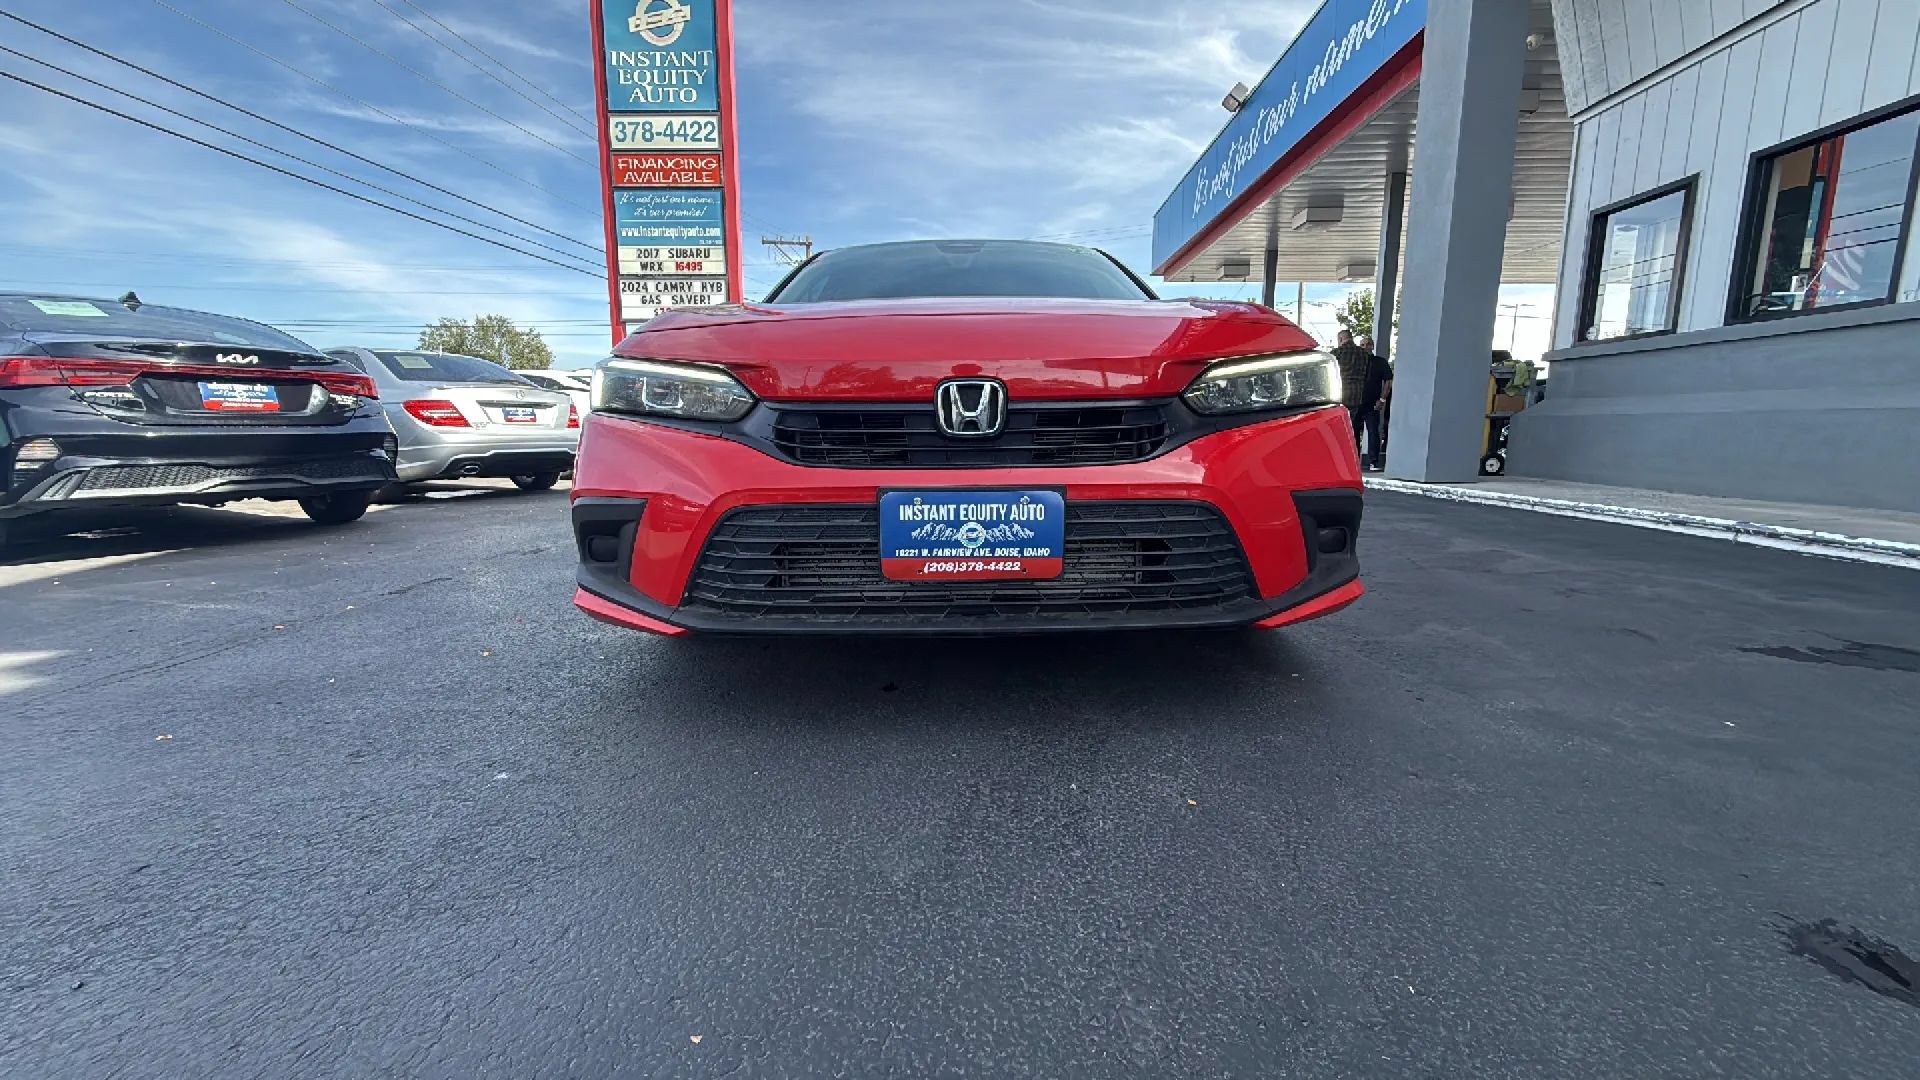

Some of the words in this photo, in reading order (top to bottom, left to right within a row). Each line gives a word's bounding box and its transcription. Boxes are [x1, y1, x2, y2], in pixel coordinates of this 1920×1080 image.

[610, 50, 713, 67] INSTANT
[618, 69, 707, 87] EQUITY
[629, 87, 698, 103] AUTO
[614, 120, 717, 143] 378-4422
[617, 157, 718, 170] FINANCING
[623, 171, 716, 183] AVAILABLE
[637, 248, 660, 259] 2017
[668, 248, 711, 259] SUBARU
[640, 262, 664, 271] WRX
[675, 261, 703, 271] 16495
[621, 282, 649, 293] 2024
[656, 282, 693, 293] CAMRY
[701, 282, 723, 293] HYB
[641, 295, 662, 305] GAS
[671, 294, 711, 305] SAVER!
[899, 503, 956, 521] INSTANT
[959, 503, 1008, 521] EQUITY
[1010, 503, 1045, 521] AUTO
[921, 548, 931, 557] W.
[932, 548, 975, 557] FAIRVIEW
[974, 548, 992, 557] AVE.
[994, 548, 1021, 558] BOISE,
[1023, 548, 1051, 557] IDAHO
[923, 561, 1021, 574] (208)378-4422
